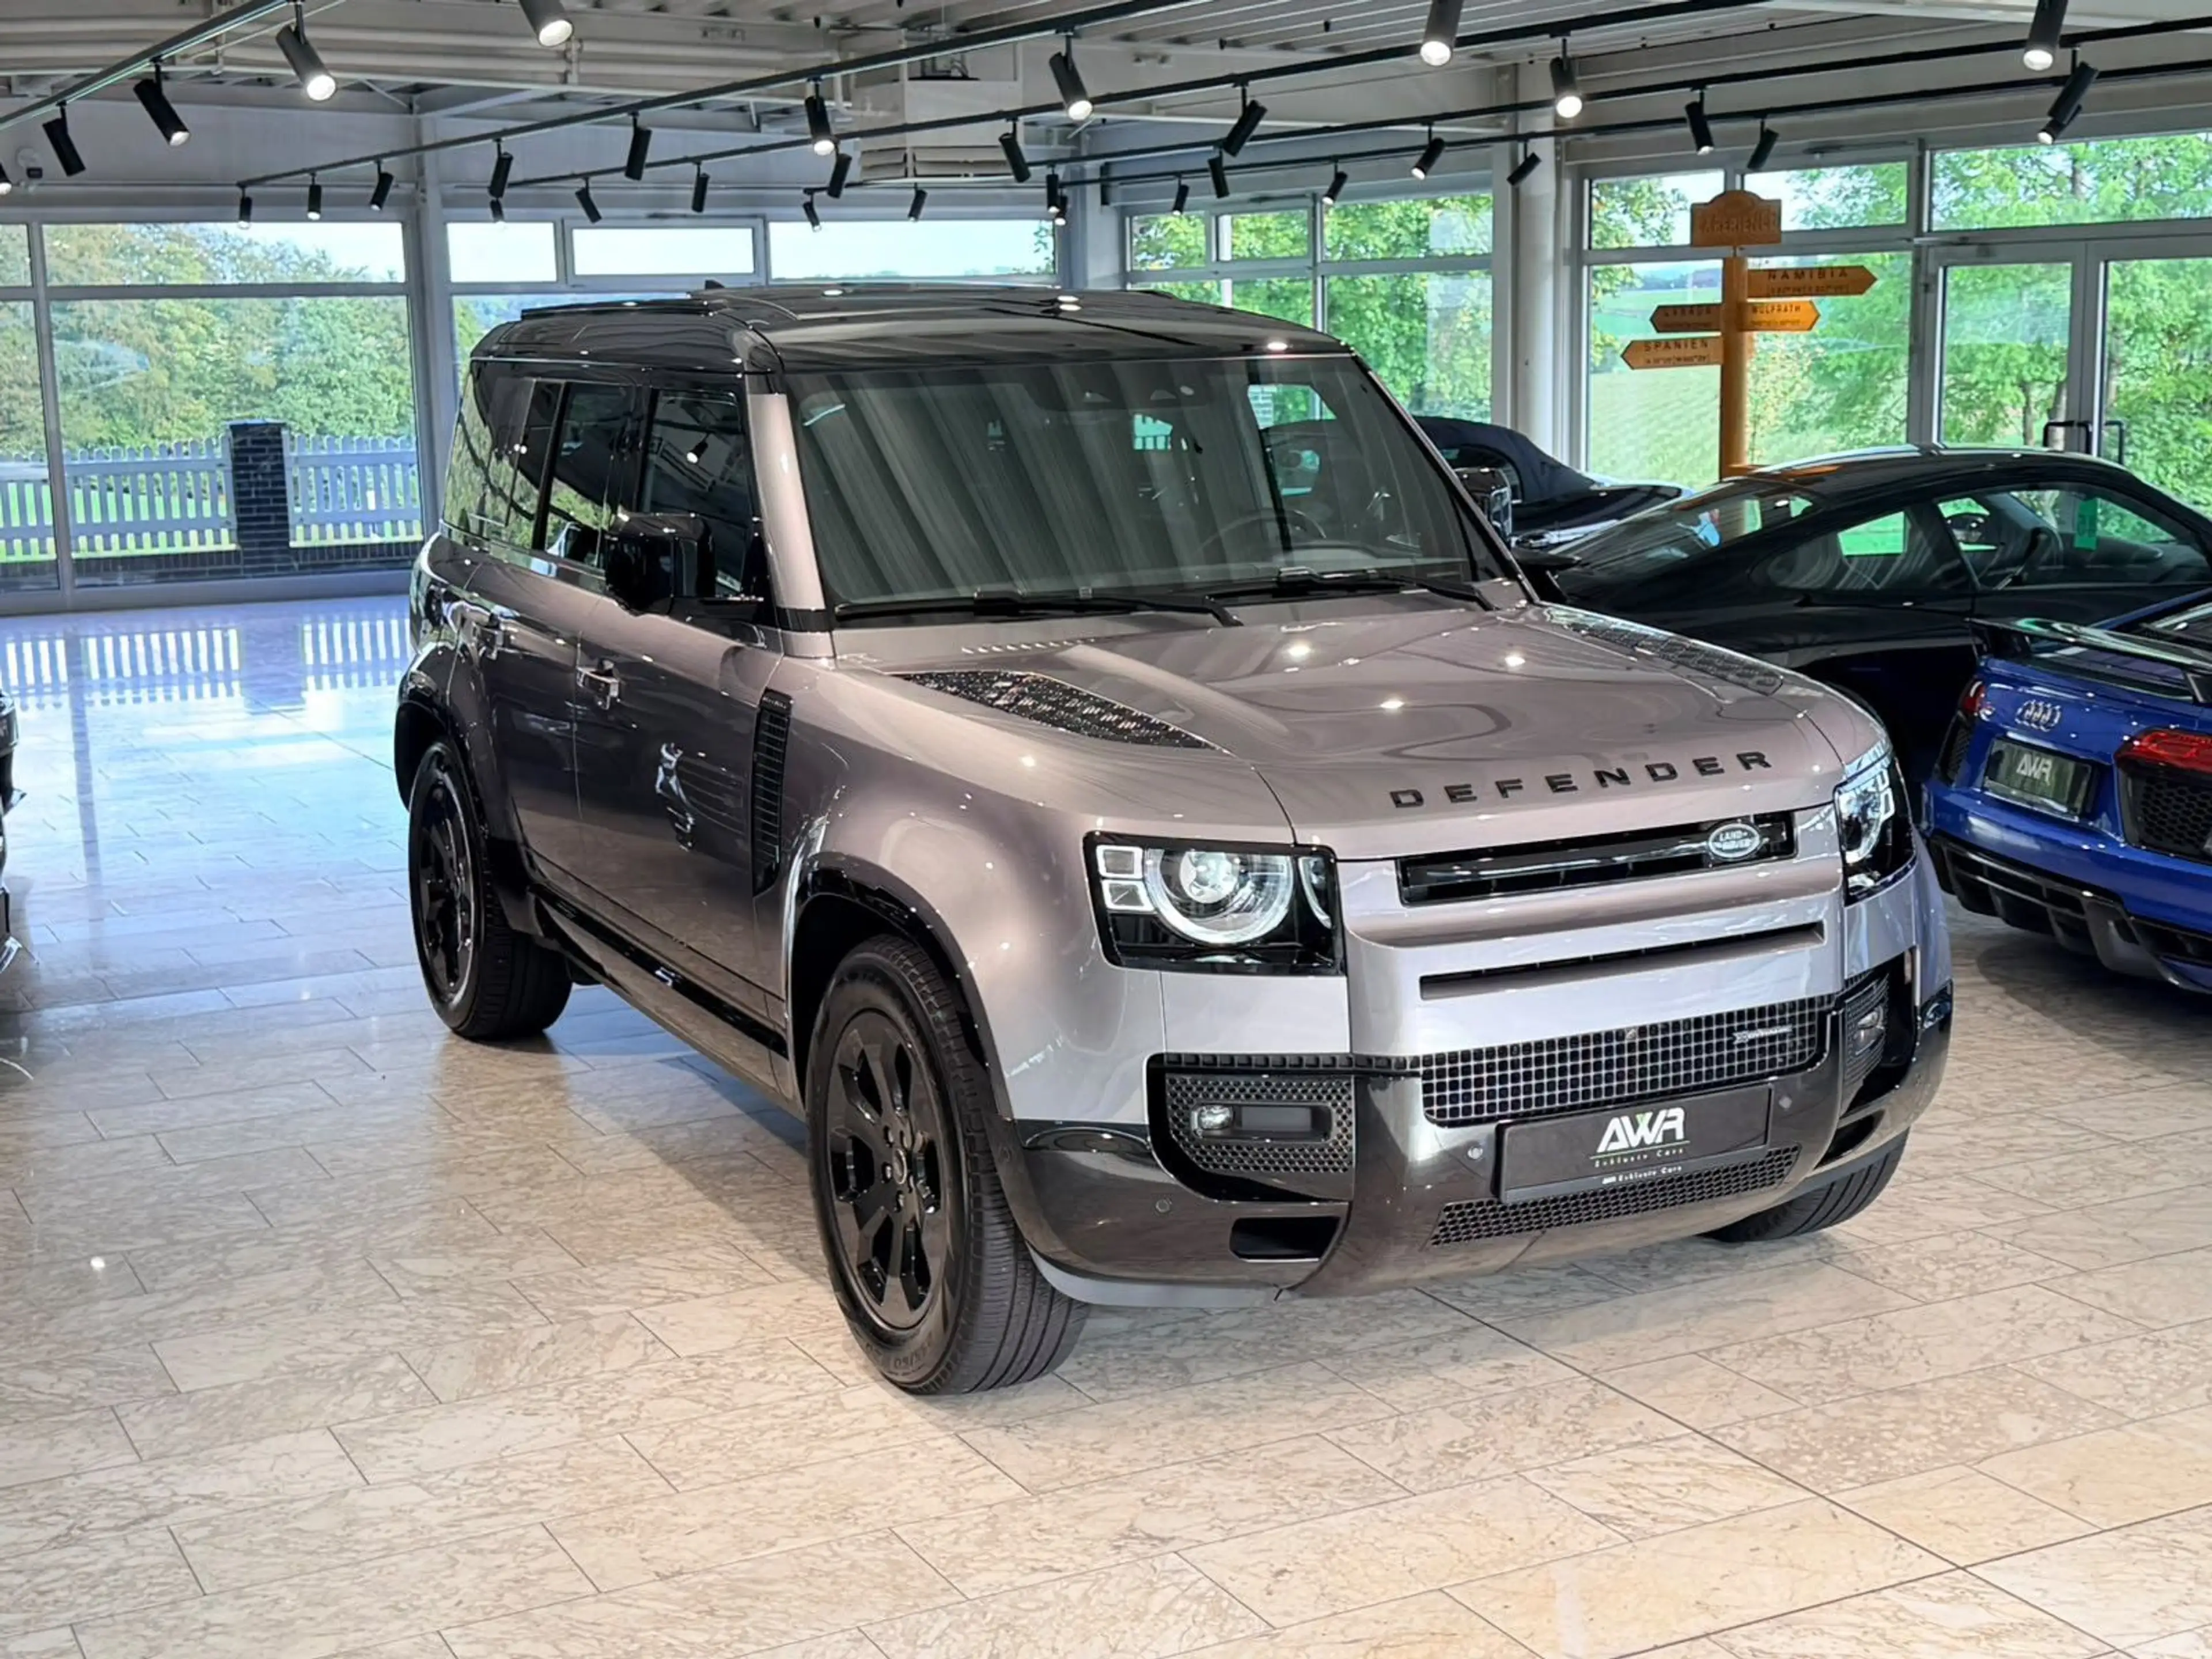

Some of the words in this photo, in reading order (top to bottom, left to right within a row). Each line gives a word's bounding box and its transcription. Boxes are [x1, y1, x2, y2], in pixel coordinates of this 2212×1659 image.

[1768, 268, 1848, 280] NAMIBIA
[1644, 339, 1709, 352] SPANIEN
[1390, 752, 1771, 808] DEFENDER
[1719, 830, 1743, 842] LAND
[1597, 1107, 1685, 1153] AWR
[1656, 1148, 1684, 1157] Cars
